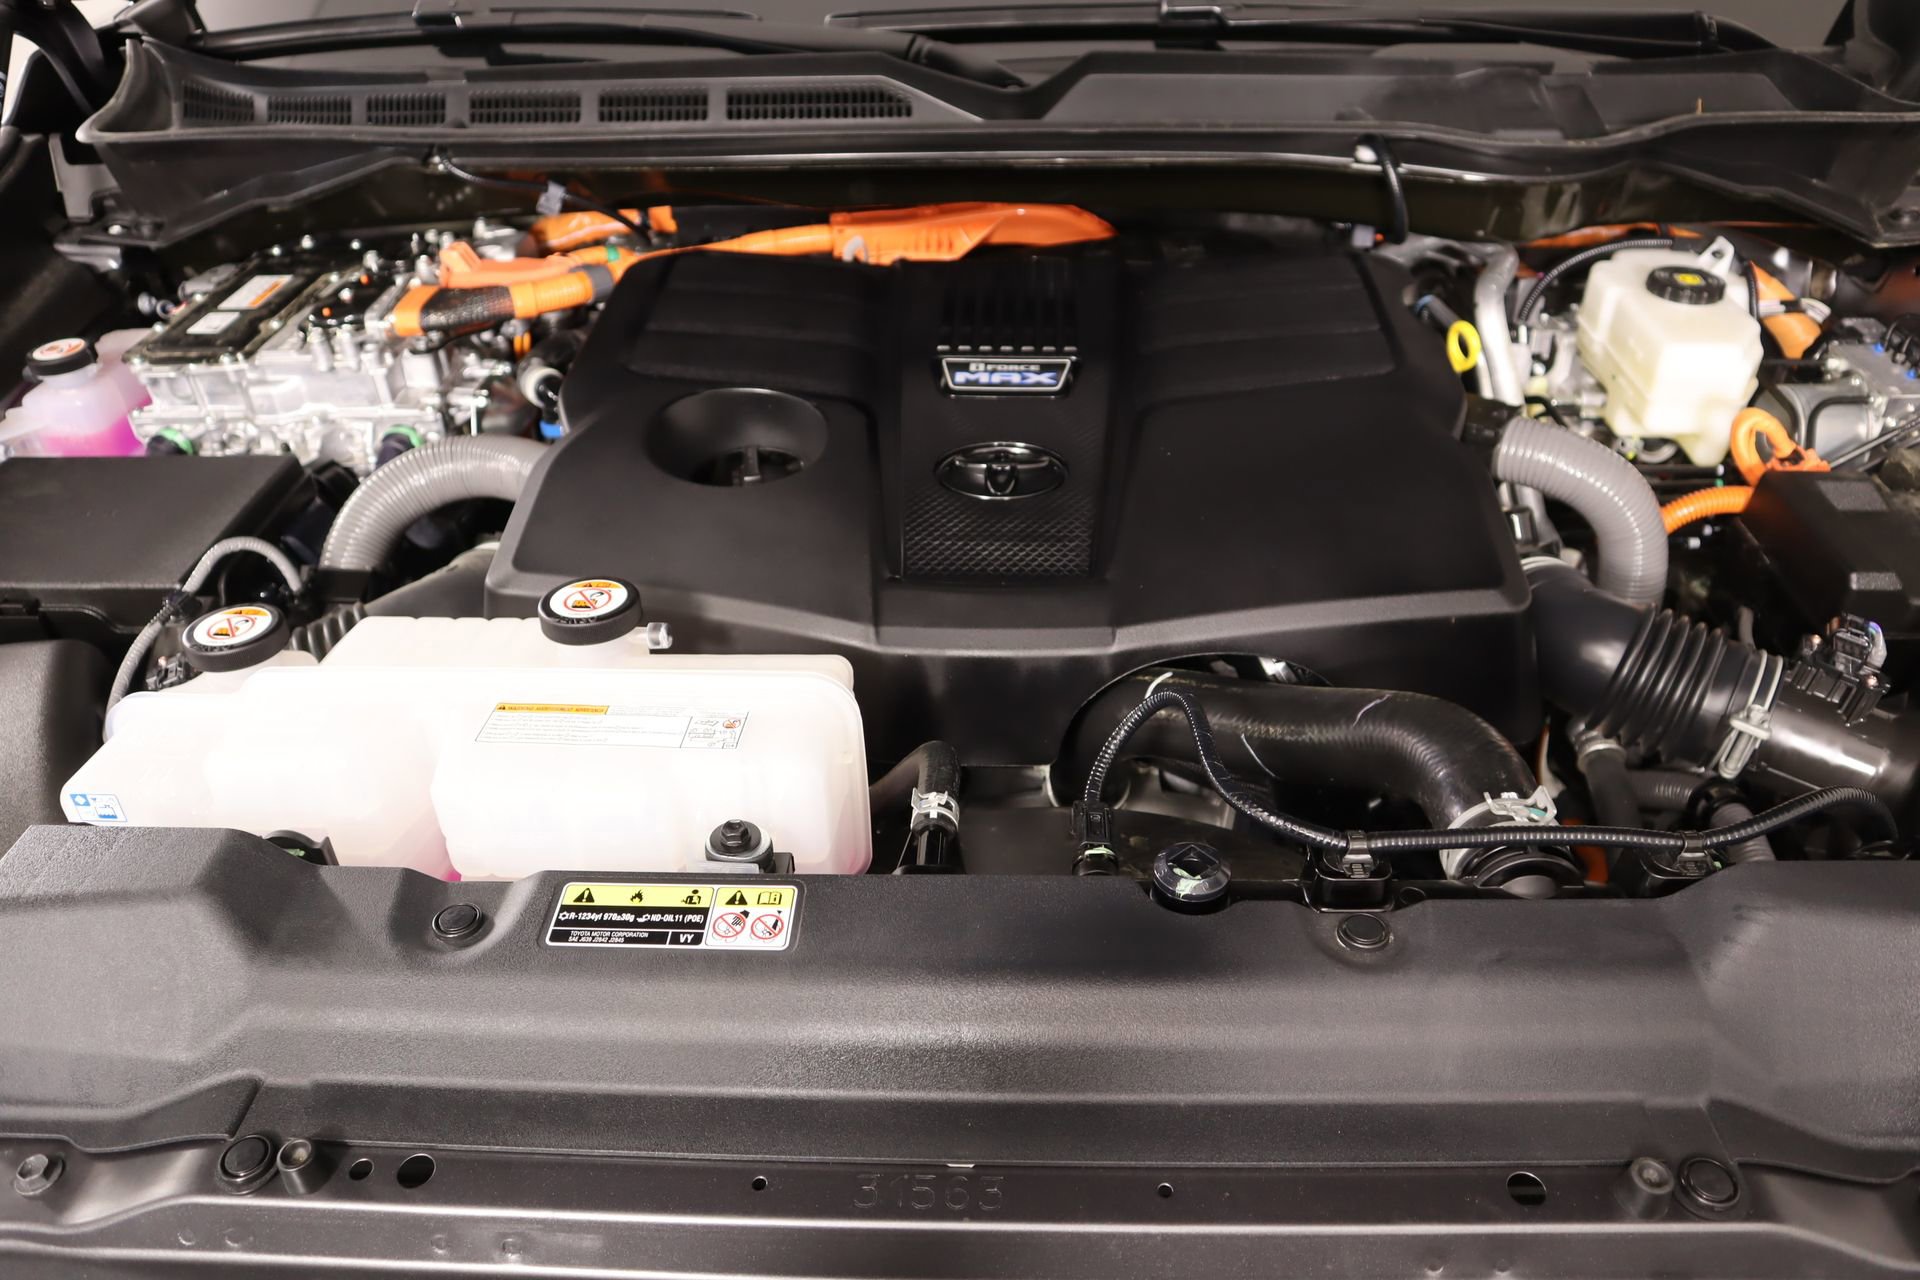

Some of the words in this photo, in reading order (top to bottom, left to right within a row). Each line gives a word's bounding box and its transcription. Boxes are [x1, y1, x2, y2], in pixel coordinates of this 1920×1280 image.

[954, 371, 1057, 385] MAX
[683, 914, 704, 924] (POE)
[570, 930, 591, 938] TOYOTA
[611, 931, 649, 939] CORPORATION
[679, 933, 695, 943] VY
[853, 1173, 1005, 1211] 31563
